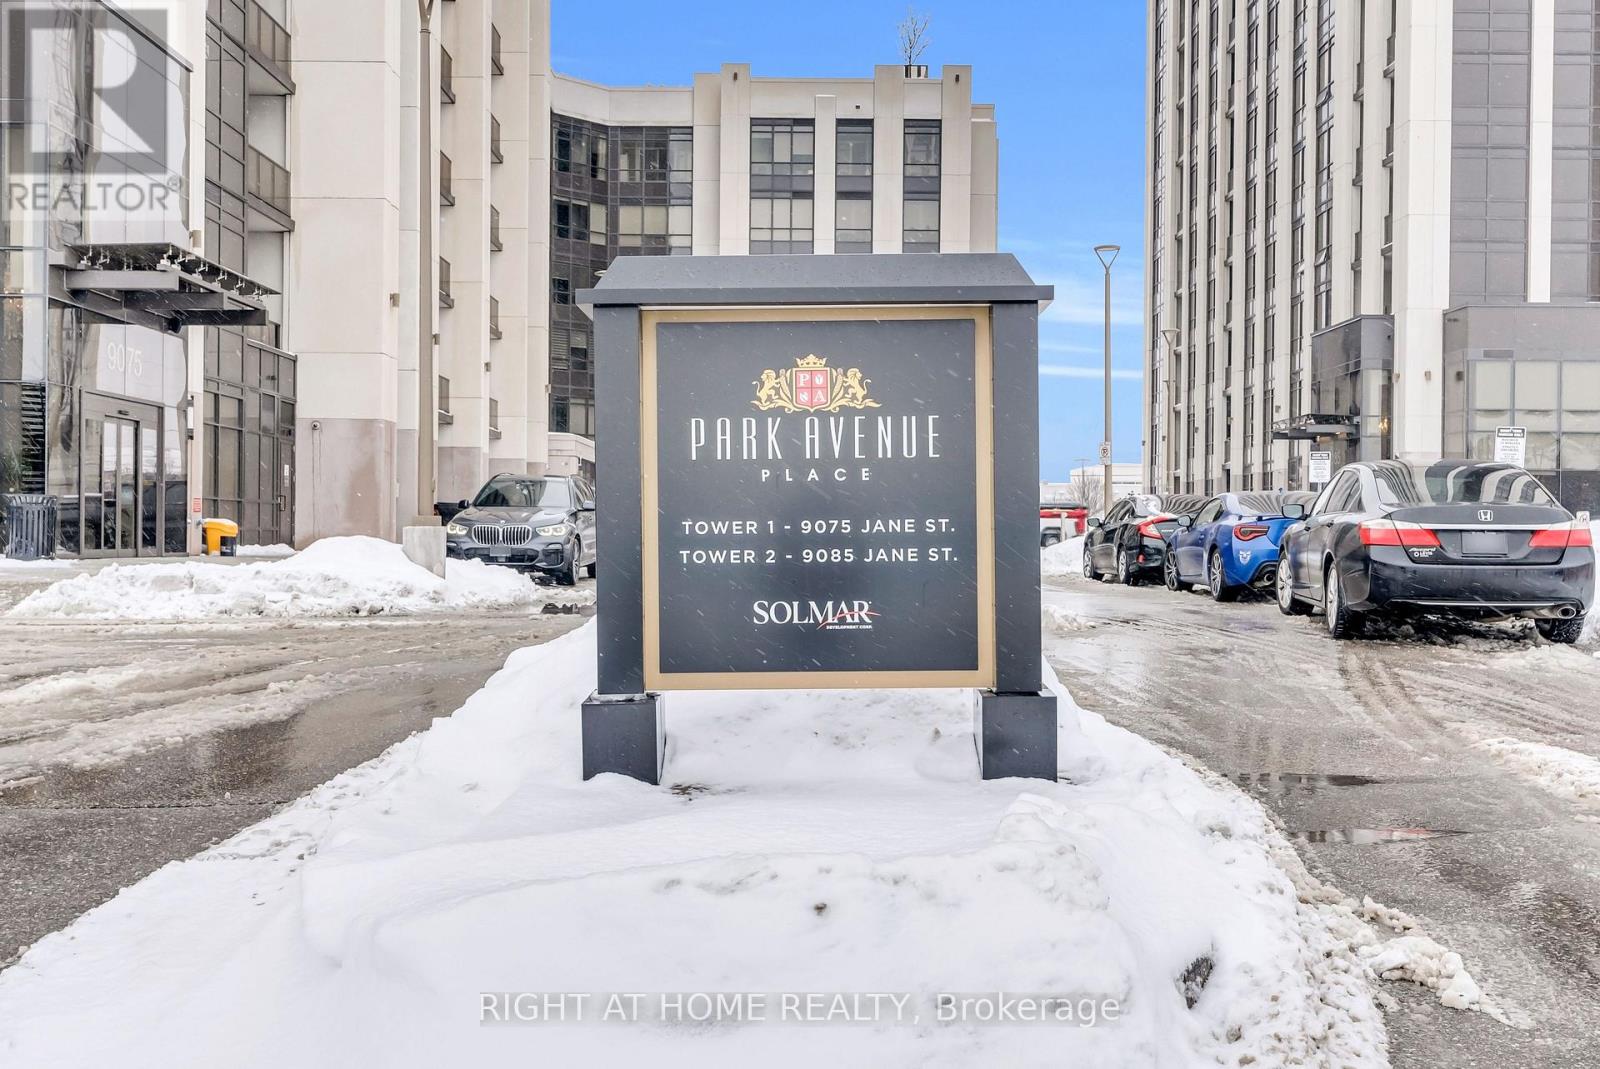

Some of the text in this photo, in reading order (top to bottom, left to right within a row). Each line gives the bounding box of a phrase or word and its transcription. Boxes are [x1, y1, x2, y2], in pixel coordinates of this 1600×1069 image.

[107, 342, 142, 377] 9075
[690, 414, 941, 461] PARK AVENUE
[761, 467, 870, 482] PLACE
[681, 520, 758, 535] TOWER
[766, 520, 775, 535] 1
[800, 519, 851, 534] 9075
[860, 518, 916, 534] JANE
[925, 518, 956, 533] ST.
[679, 549, 756, 564] TOWER
[765, 549, 776, 564] 2
[802, 548, 854, 563] 9085
[863, 547, 919, 563] JANE
[928, 547, 959, 562] ST.
[753, 600, 873, 624] SOLMAR
